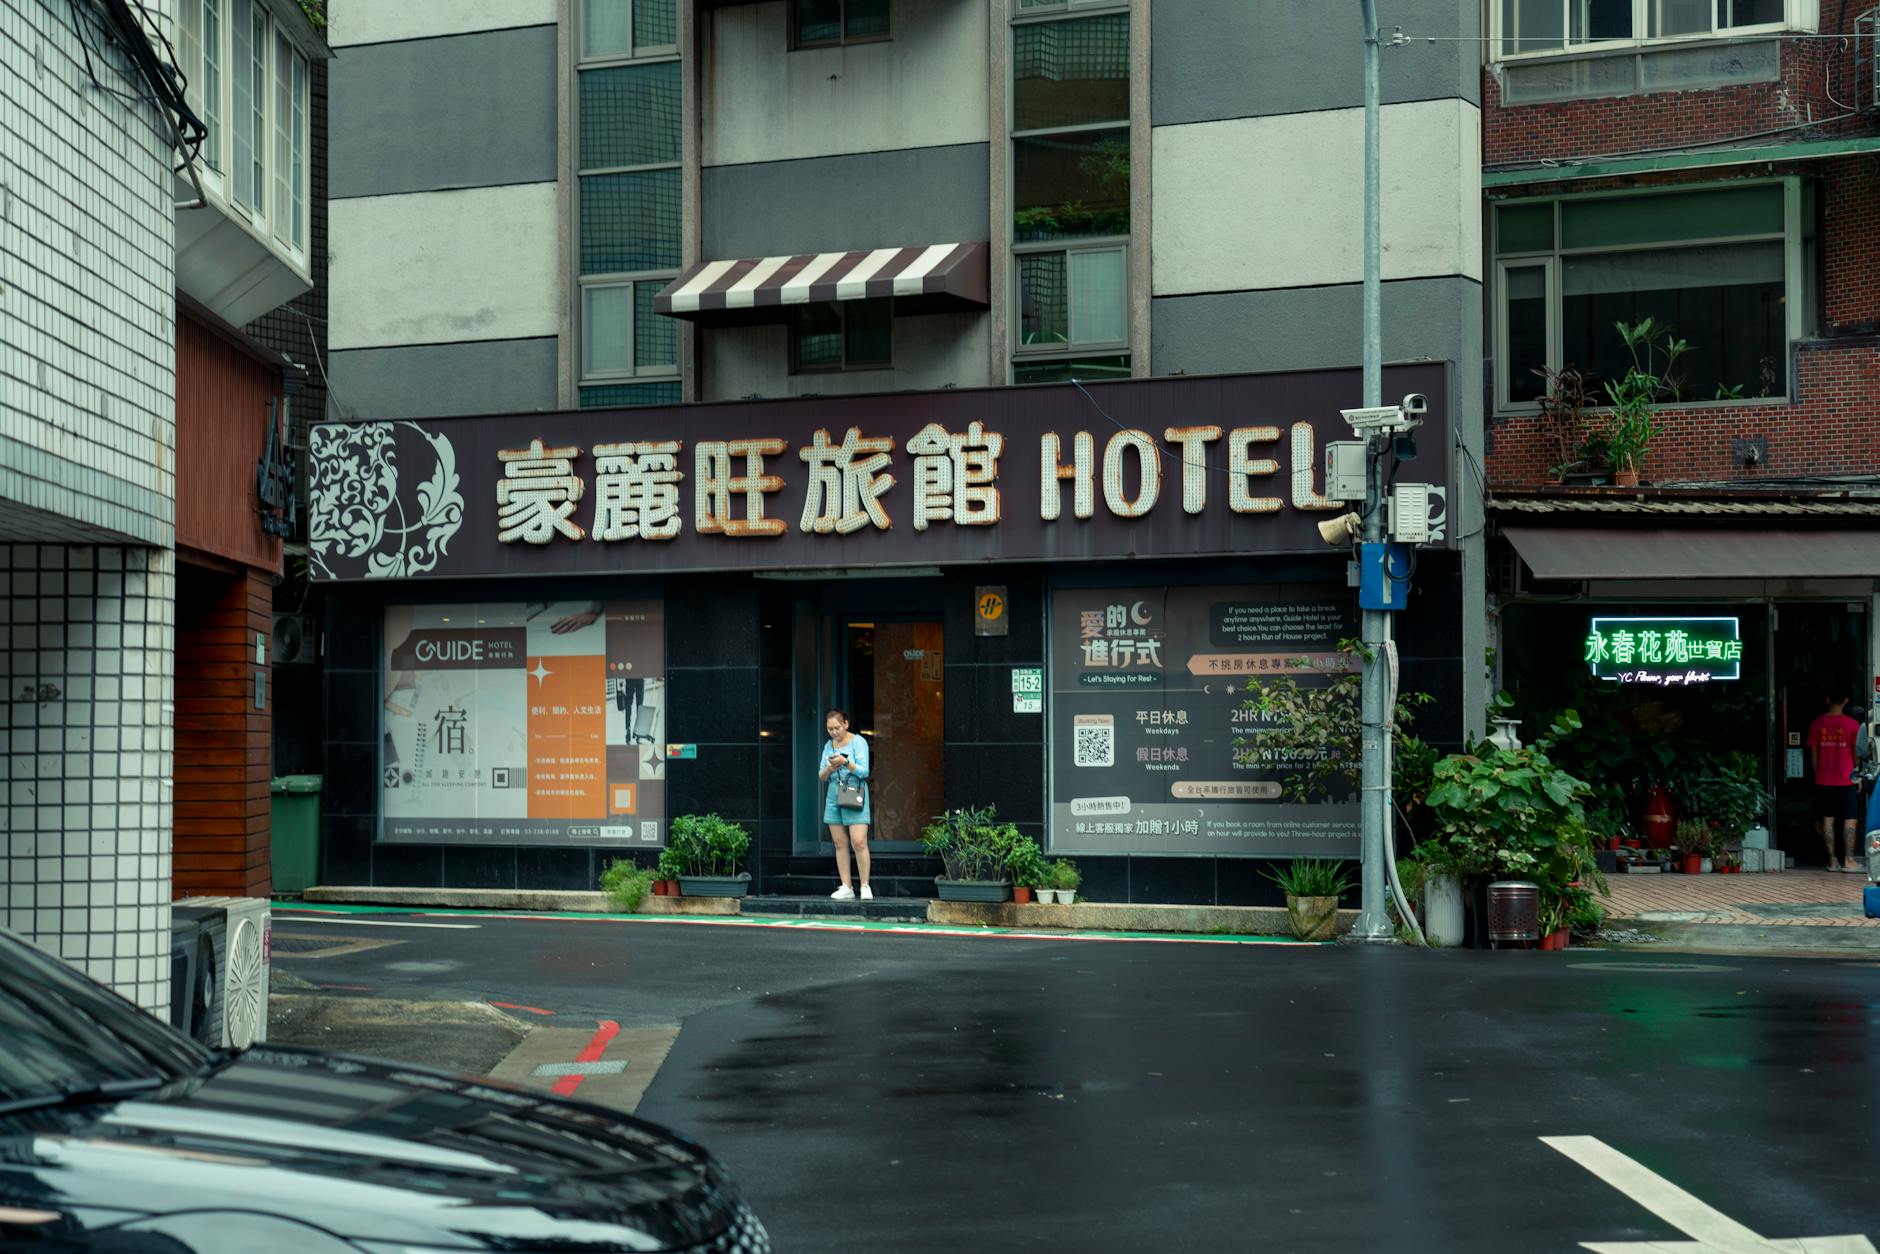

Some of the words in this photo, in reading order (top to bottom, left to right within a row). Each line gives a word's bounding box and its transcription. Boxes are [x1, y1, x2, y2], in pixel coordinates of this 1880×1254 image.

[1040, 418, 1345, 521] HOTEL
[495, 419, 1004, 545] 豪麗旺旅館
[416, 640, 483, 662] GUIDE
[1080, 638, 1163, 668] 進行式
[1584, 630, 1742, 664] 永春花苑世貿店
[1021, 677, 1040, 689] 15-2
[1103, 675, 1126, 683] Staying
[1618, 672, 1632, 683] YC
[1136, 710, 1188, 724] 平日休息
[1136, 747, 1189, 762] 假日休息
[1136, 820, 1200, 835] 加贈1小時
